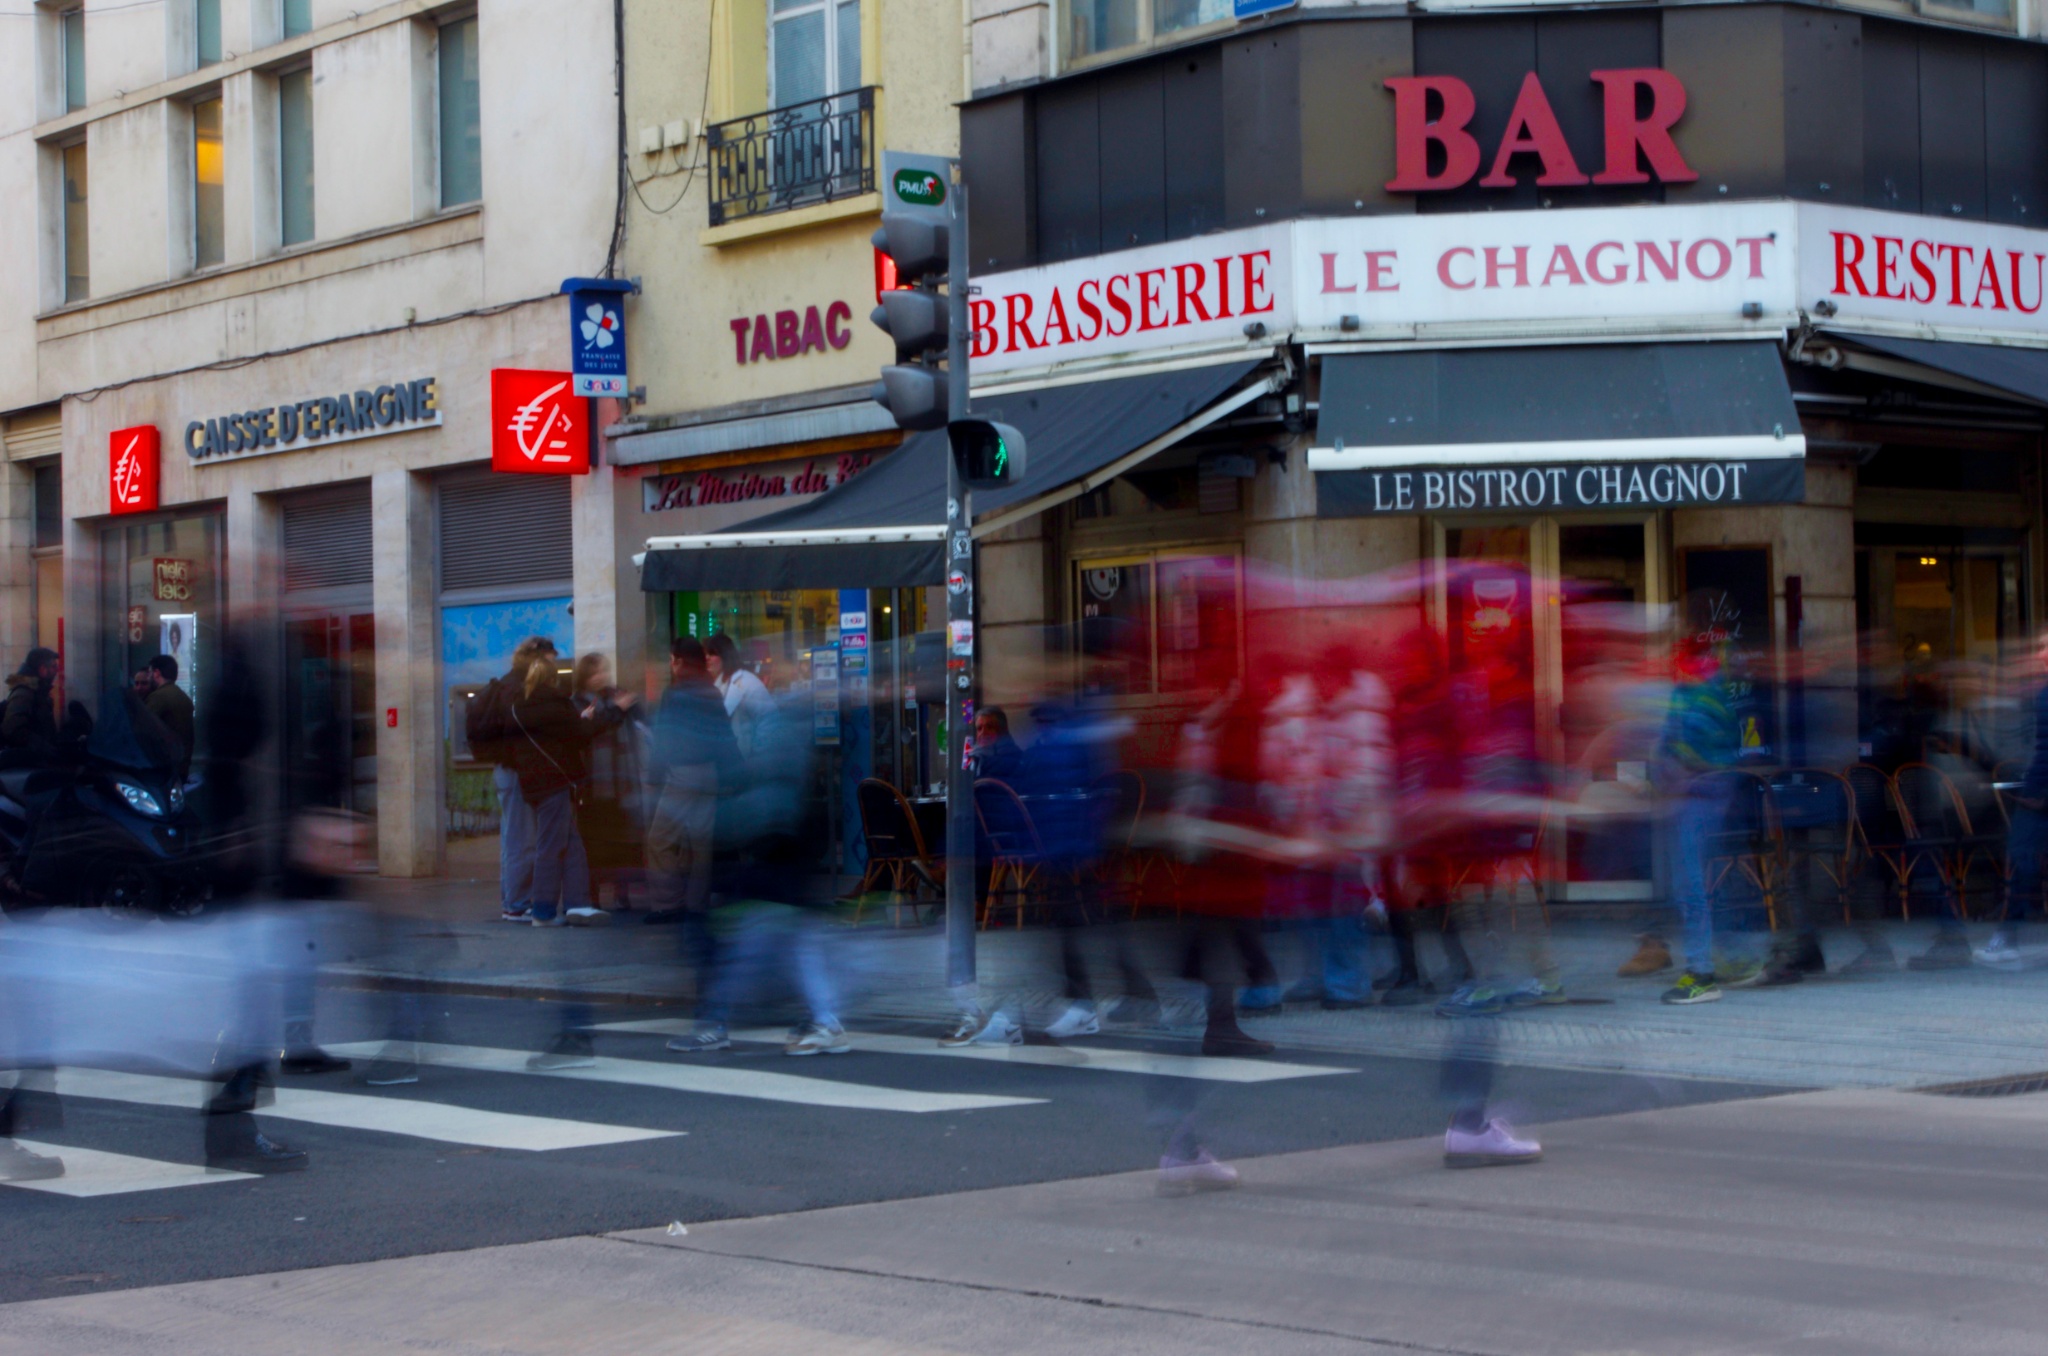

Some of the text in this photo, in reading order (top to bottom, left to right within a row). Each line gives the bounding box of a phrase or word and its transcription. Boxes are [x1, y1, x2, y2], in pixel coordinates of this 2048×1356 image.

[1383, 67, 1700, 192] BAR
[898, 179, 925, 195] PMU
[1319, 236, 1776, 294] LE CHAGNOT
[1829, 229, 2047, 315] RESTAU
[729, 299, 852, 365] TABAC
[969, 249, 1275, 359] BRASSERIE
[600, 361, 618, 369] JEUX
[184, 377, 437, 459] CAISSE D'EPARGNE
[651, 477, 694, 511] La
[696, 472, 786, 506] Maison
[791, 461, 830, 495] du
[1372, 462, 1748, 512] LE BISTROT CHAGNOT
